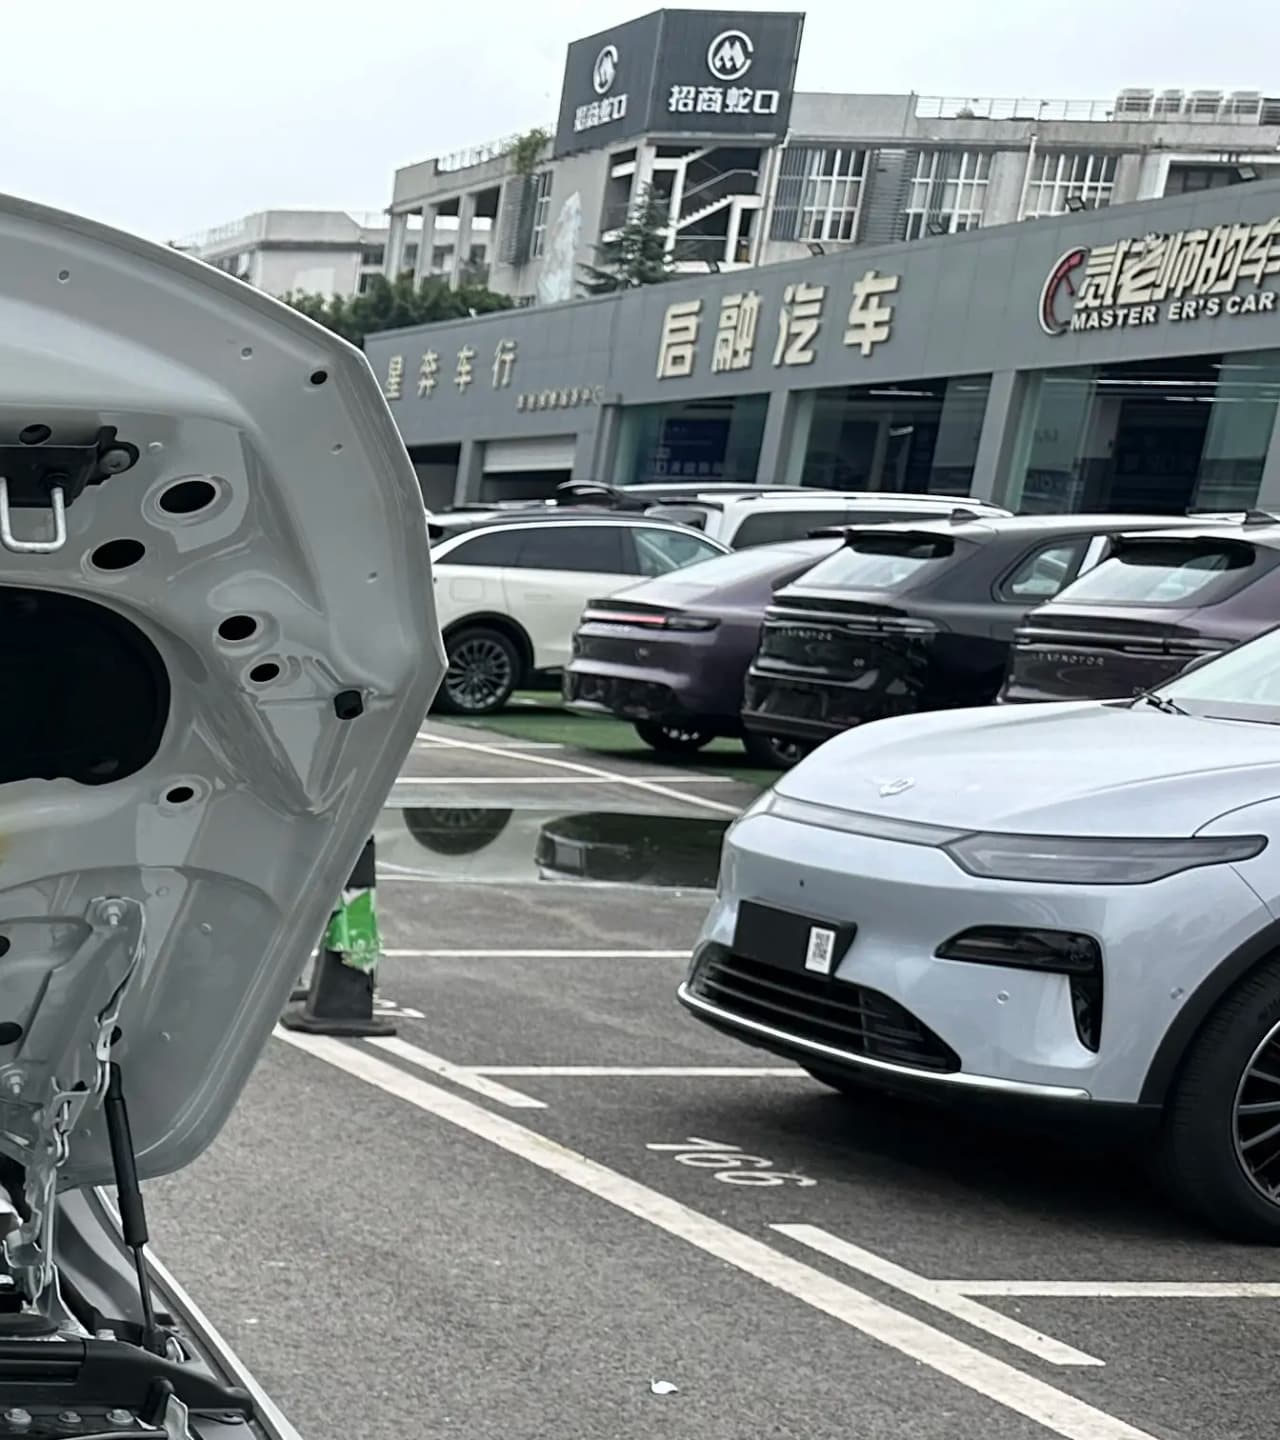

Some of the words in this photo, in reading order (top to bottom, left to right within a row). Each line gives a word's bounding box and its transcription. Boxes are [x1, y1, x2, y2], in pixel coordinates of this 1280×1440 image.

[668, 84, 780, 114] 招商蛇口
[656, 270, 899, 379] 启融汽车
[1070, 305, 1157, 332] MASTER
[1168, 297, 1220, 320] ER'S
[1225, 291, 1276, 314] CAR
[645, 1136, 818, 1187] 166
